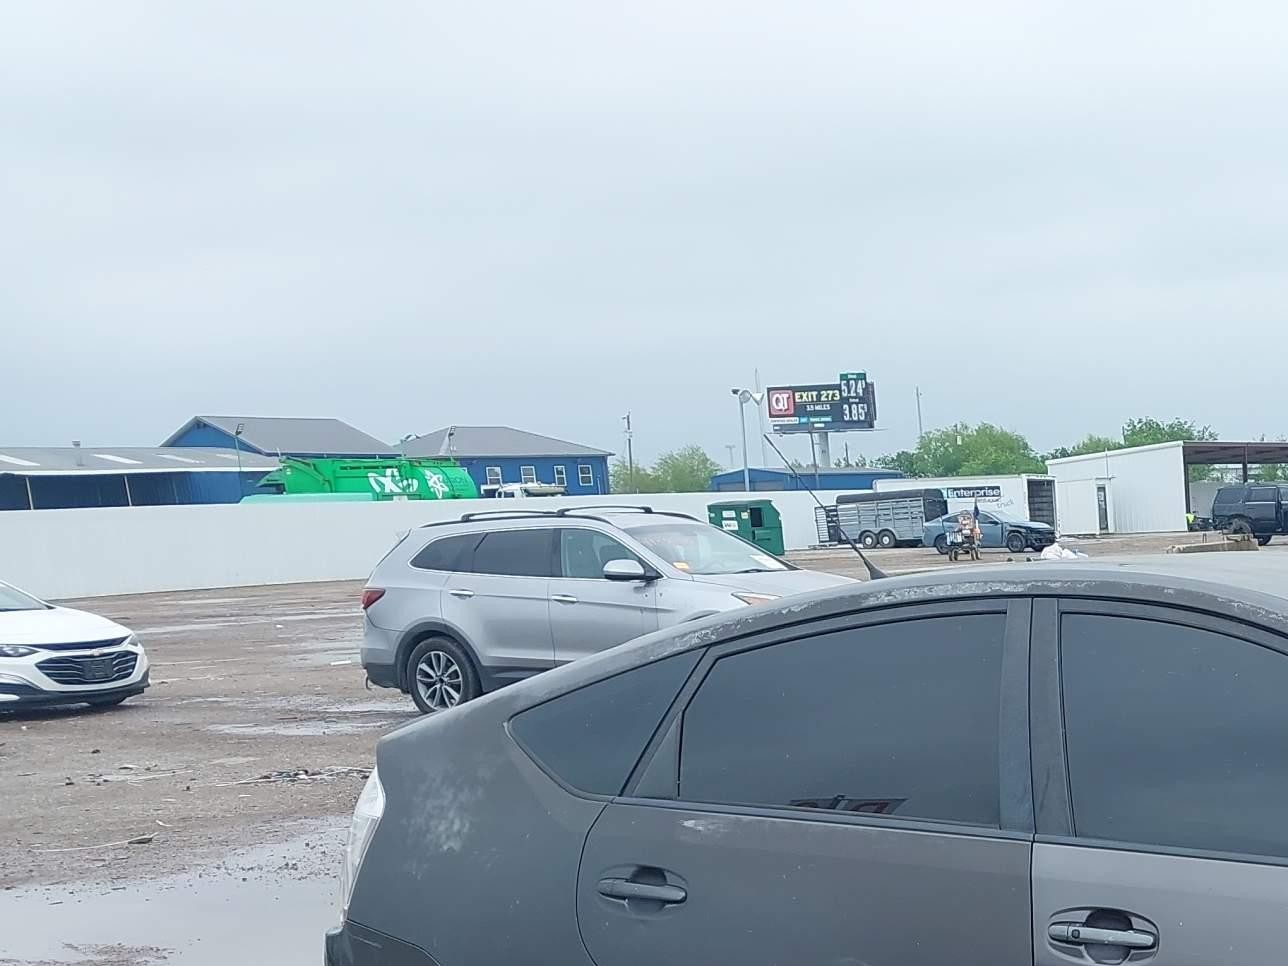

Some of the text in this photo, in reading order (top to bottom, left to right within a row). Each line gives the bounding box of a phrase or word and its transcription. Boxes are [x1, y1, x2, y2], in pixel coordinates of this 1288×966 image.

[794, 390, 840, 402] EXIT 273
[772, 393, 790, 412] QT
[948, 487, 1001, 498] Enterprise
